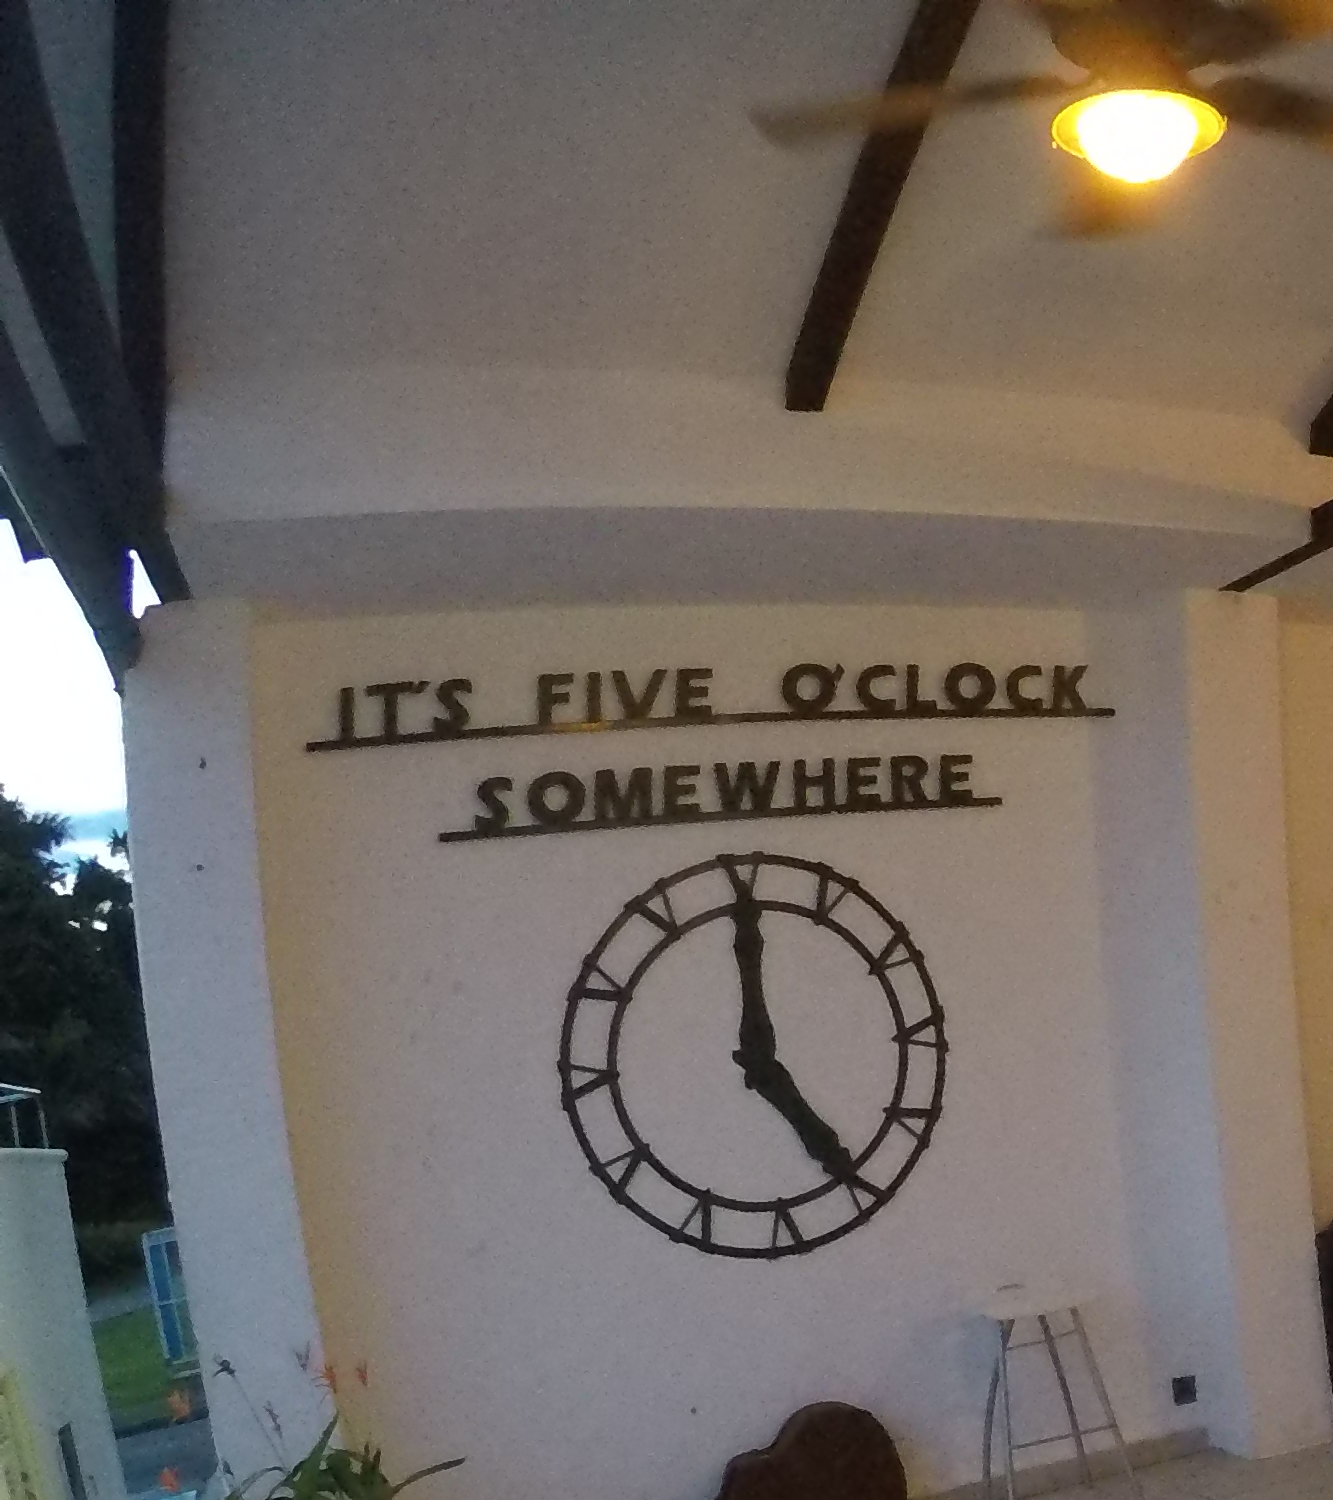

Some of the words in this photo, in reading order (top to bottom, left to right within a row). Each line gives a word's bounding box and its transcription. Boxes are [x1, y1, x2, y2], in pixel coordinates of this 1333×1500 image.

[338, 678, 473, 740] IT'S
[536, 667, 713, 726] FIVE
[780, 662, 1089, 716] O'CLOCK
[475, 754, 973, 832] SOMEWHERE
